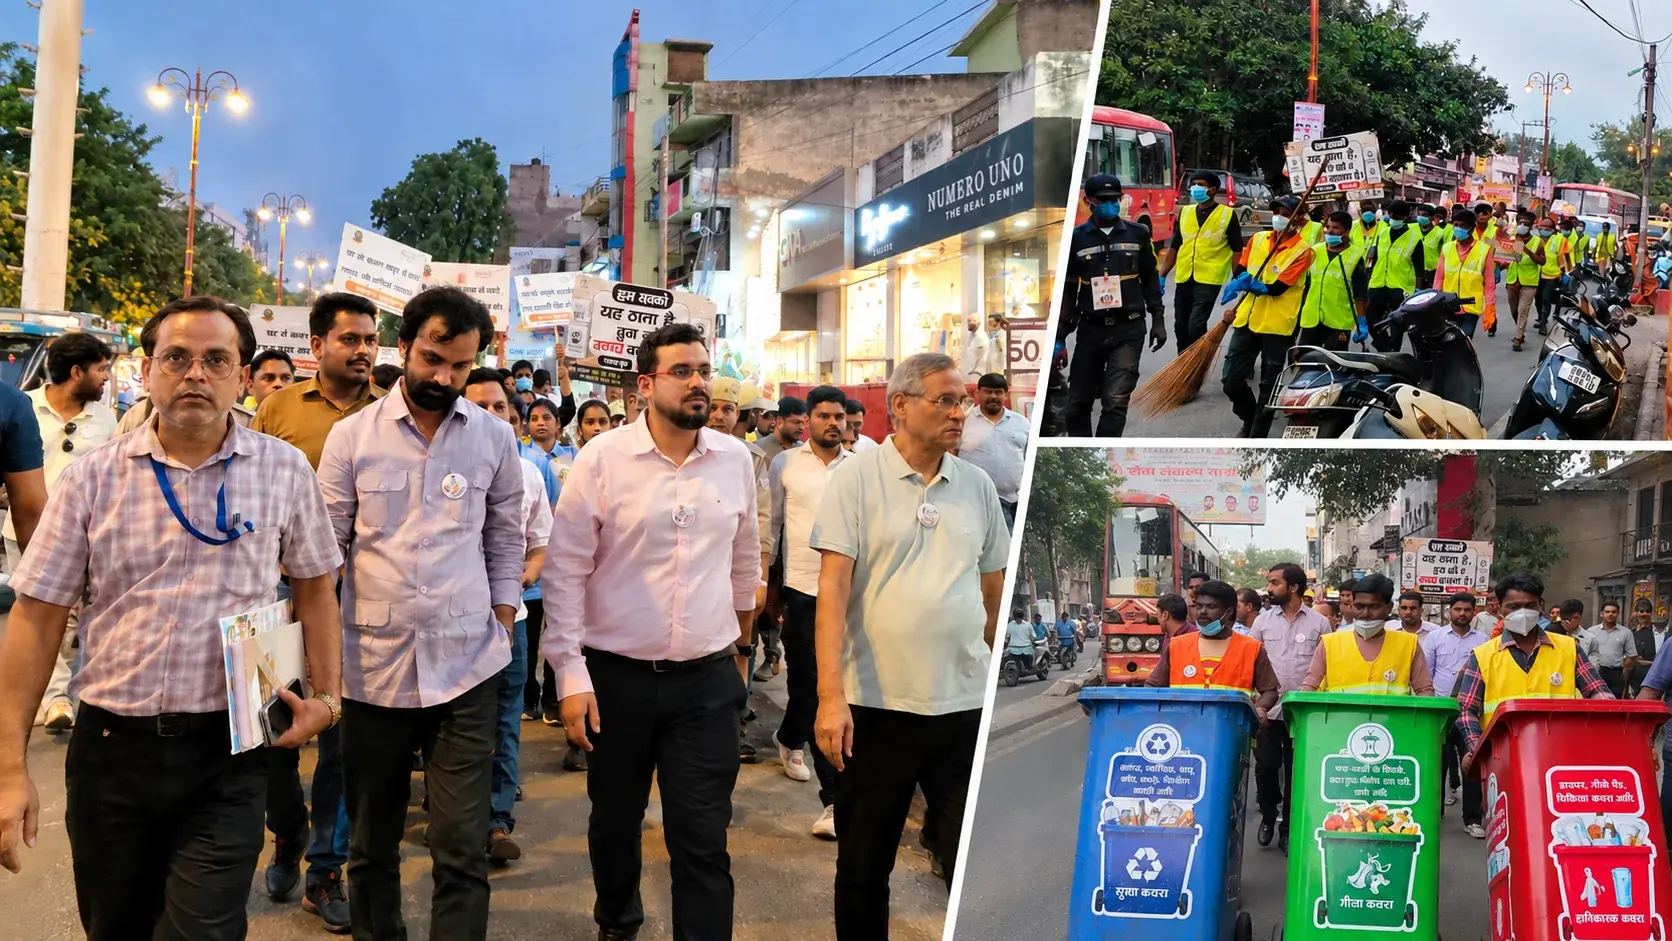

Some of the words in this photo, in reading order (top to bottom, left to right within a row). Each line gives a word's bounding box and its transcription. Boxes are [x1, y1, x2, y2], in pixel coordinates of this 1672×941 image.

[928, 170, 985, 213] NUMERO
[989, 153, 1024, 187] UNO
[945, 207, 961, 220] THE
[964, 198, 986, 214] REAL
[989, 181, 1024, 204] DENIM
[1009, 339, 1040, 362] 50
[1339, 894, 1364, 908] गीला
